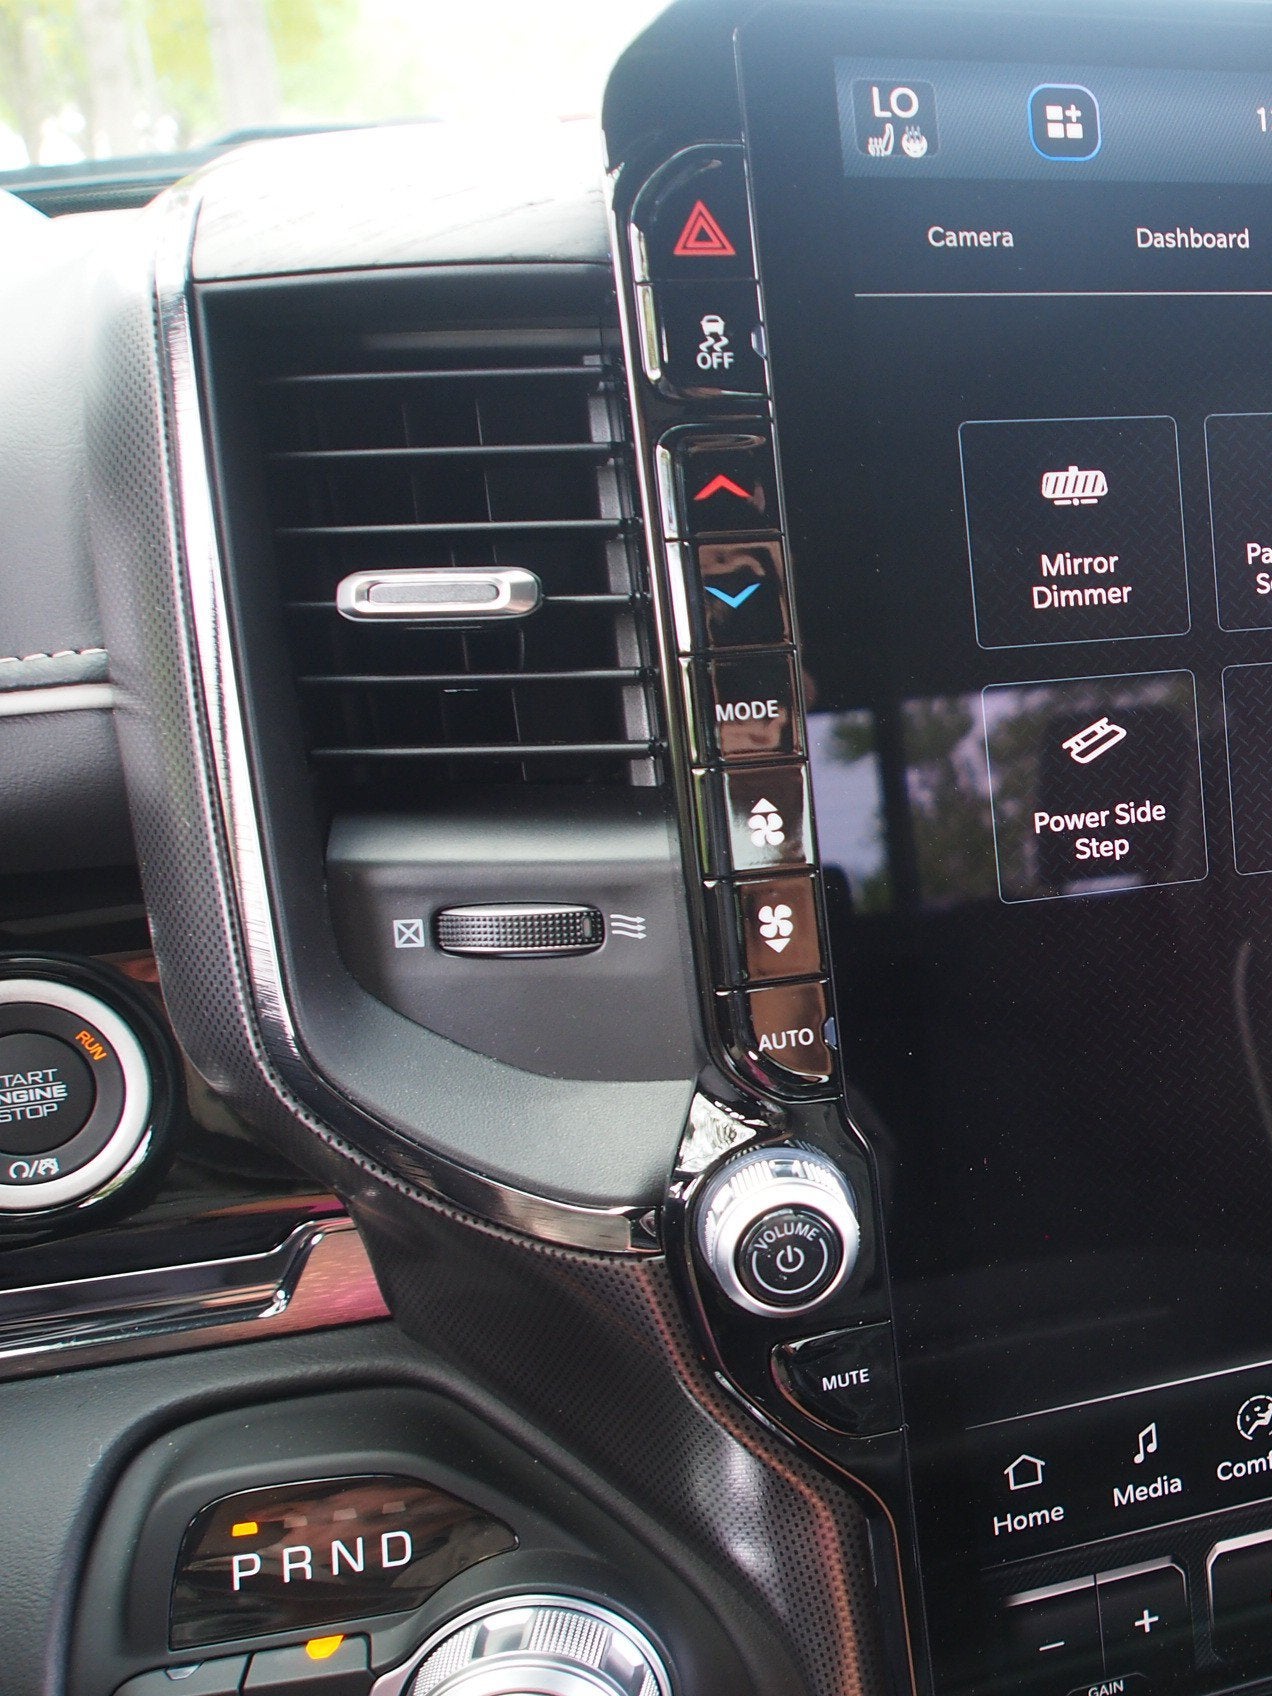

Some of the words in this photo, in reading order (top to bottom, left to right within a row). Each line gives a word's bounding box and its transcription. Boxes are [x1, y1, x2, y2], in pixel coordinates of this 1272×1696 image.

[872, 86, 919, 119] LO
[927, 226, 1014, 247] Camera
[1136, 227, 1250, 249] Dashboard
[697, 352, 734, 370] OFF
[1041, 551, 1119, 577] Mirror
[1032, 584, 1133, 609] Dimmer
[715, 699, 780, 722] MODE
[1033, 810, 1110, 834] Power
[1114, 799, 1166, 825] Side
[1075, 837, 1130, 861] Step
[75, 1030, 108, 1061] RUN
[758, 1027, 814, 1052] AUTO
[0, 1069, 58, 1087] TART
[0, 1085, 68, 1103] NGINE
[0, 1103, 58, 1123] STOP
[754, 1223, 821, 1251] VOLUME
[822, 1368, 870, 1391] MUTE
[1113, 1475, 1182, 1507] Media
[993, 1505, 1064, 1536] Home
